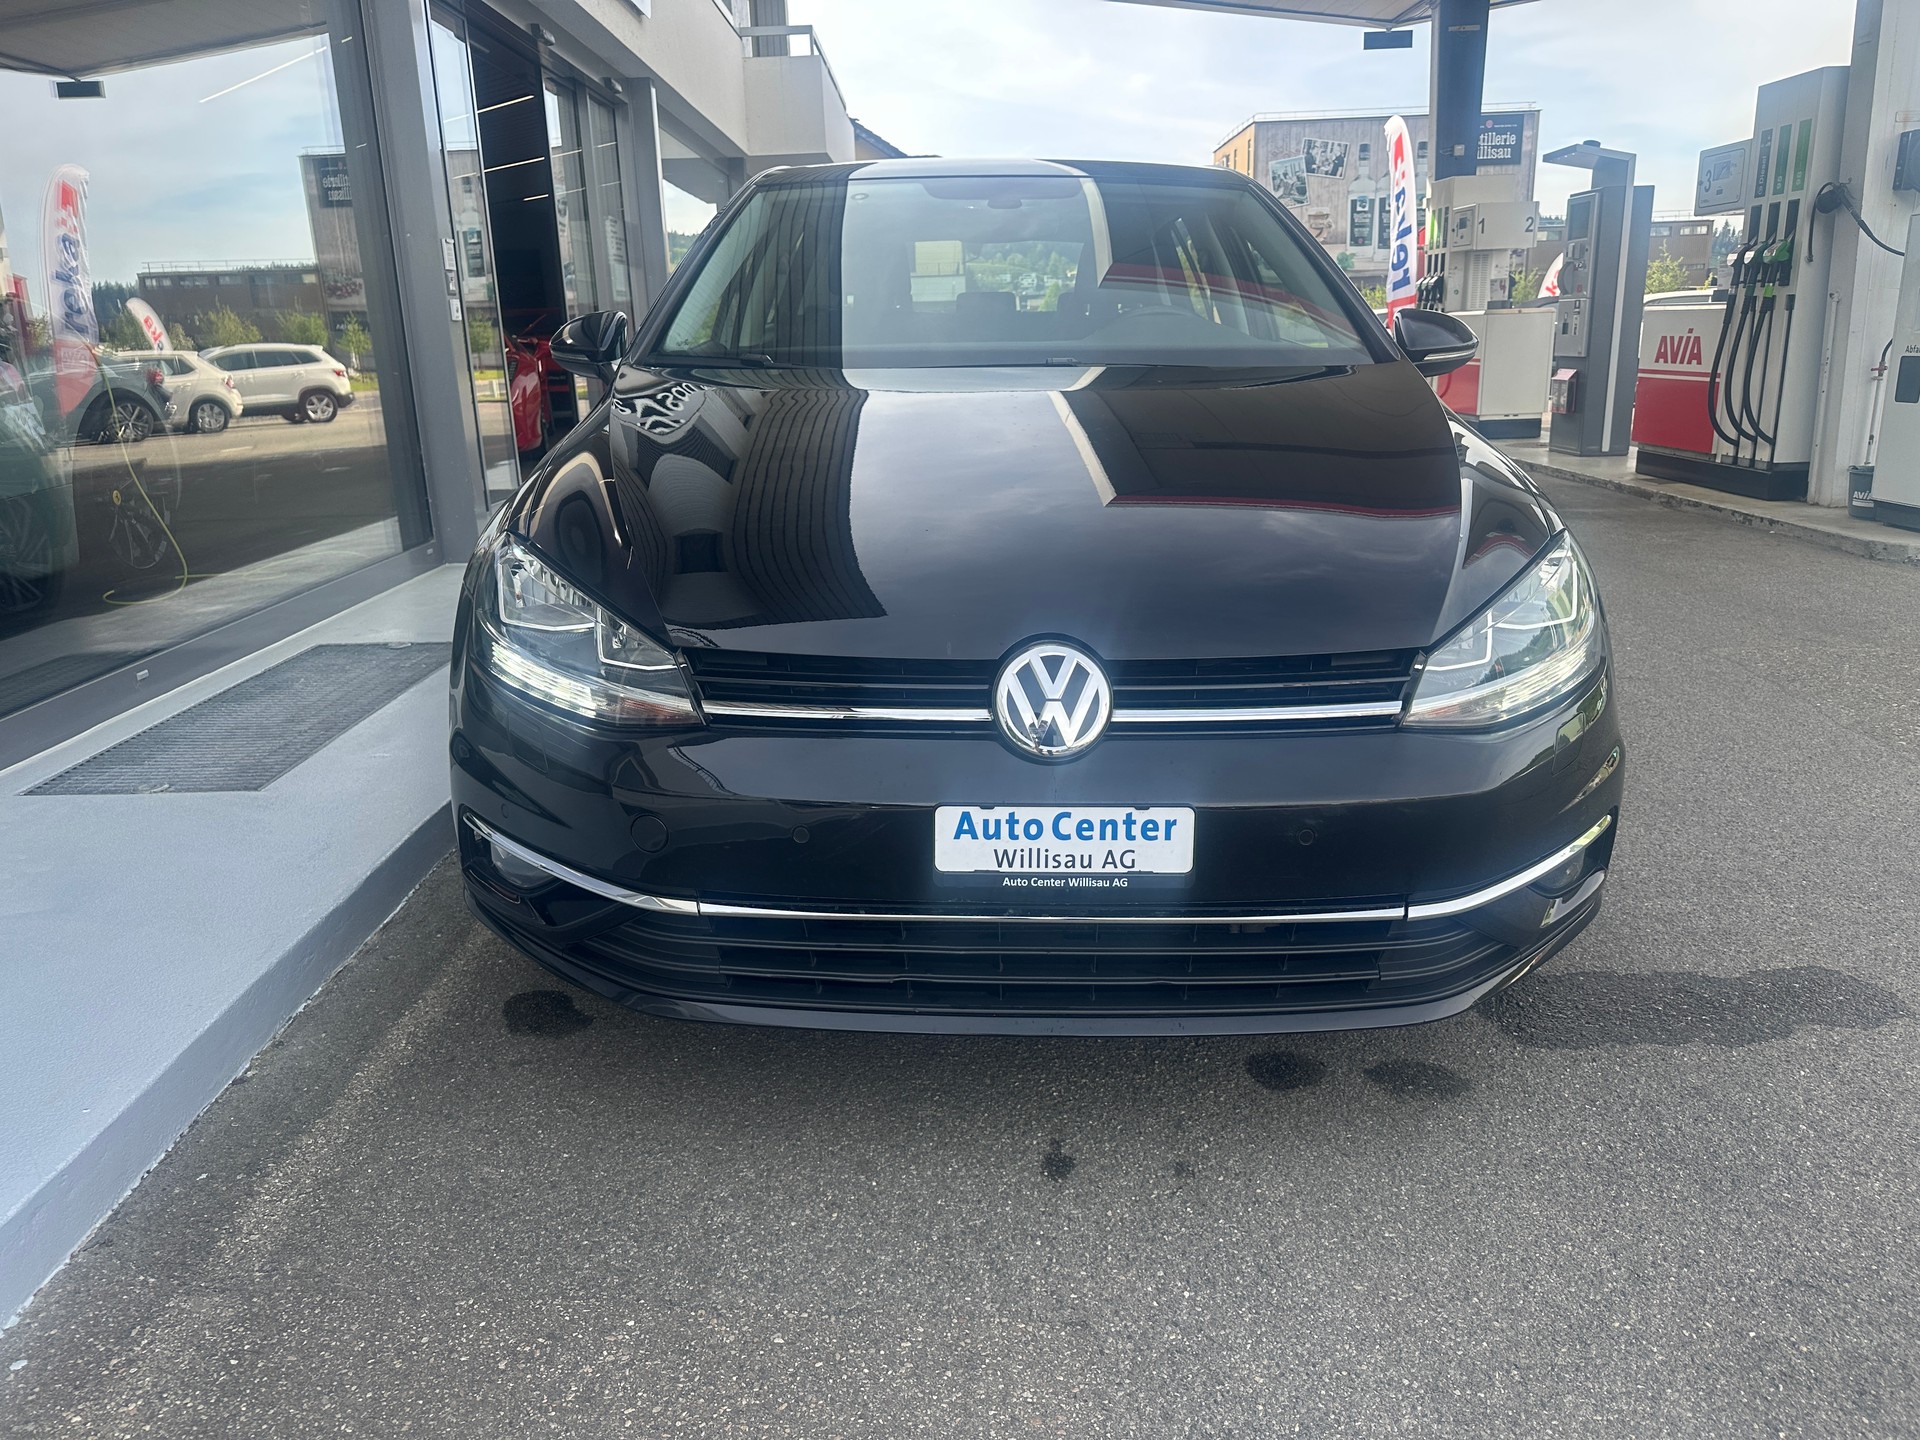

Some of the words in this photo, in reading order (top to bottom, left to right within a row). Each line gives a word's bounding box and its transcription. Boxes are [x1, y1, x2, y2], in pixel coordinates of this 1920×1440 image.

[1704, 169, 1712, 193] 3
[1479, 218, 1485, 234] 1
[1525, 217, 1534, 232] 2
[1654, 328, 1702, 365] AVIA
[1905, 344, 1920, 354] Abfa
[953, 811, 1044, 841] Auto
[1051, 811, 1178, 841] Center
[993, 848, 1093, 869] Willisau
[1102, 849, 1136, 869] AG
[1003, 877, 1029, 888] Auto
[1031, 877, 1066, 888] Center
[1068, 877, 1110, 888] Willisau
[1112, 877, 1128, 888] AG
